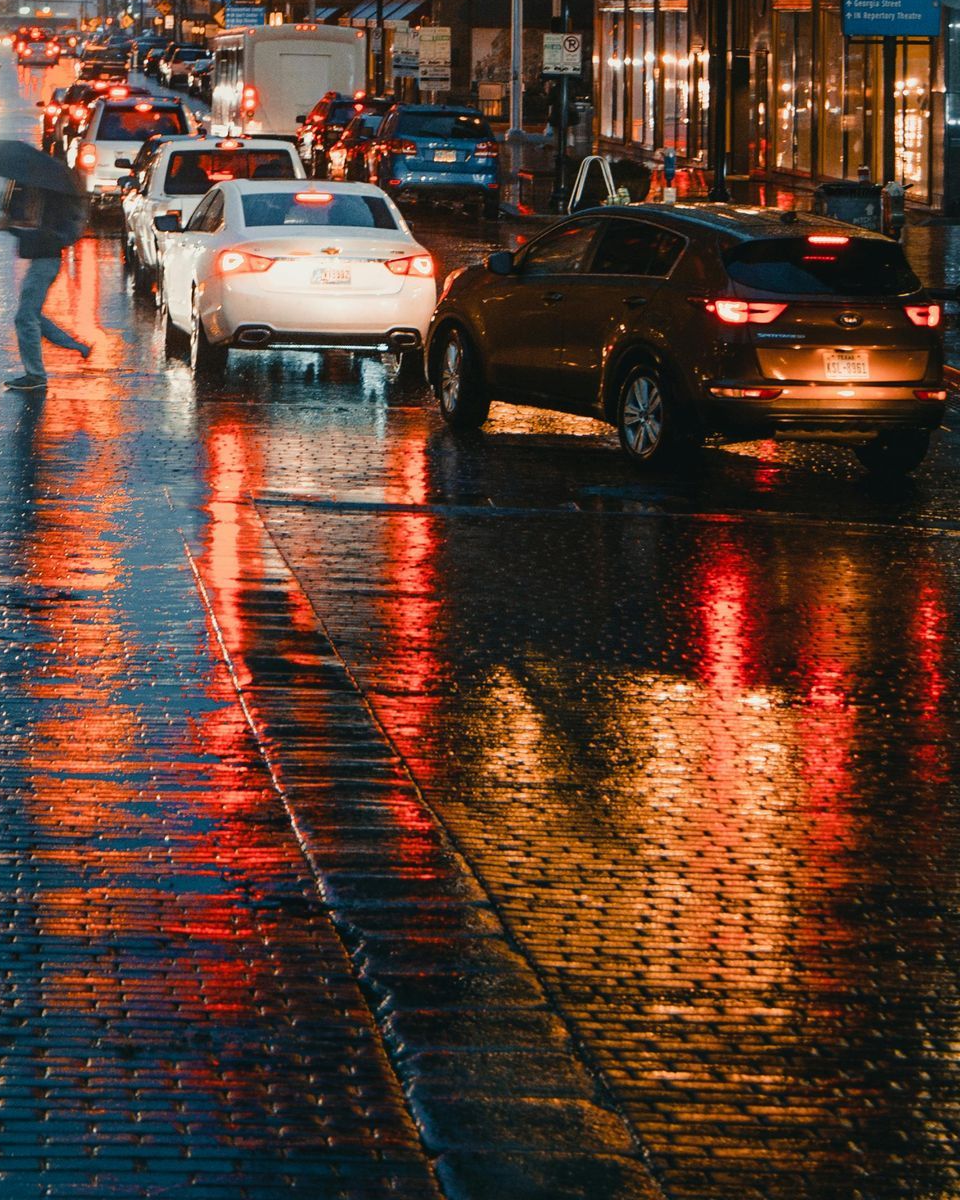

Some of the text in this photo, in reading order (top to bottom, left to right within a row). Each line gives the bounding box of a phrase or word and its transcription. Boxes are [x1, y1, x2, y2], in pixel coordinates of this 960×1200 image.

[854, 0, 880, 8] Georgia
[864, 12, 896, 21] Repertory
[897, 12, 922, 20] Theatre
